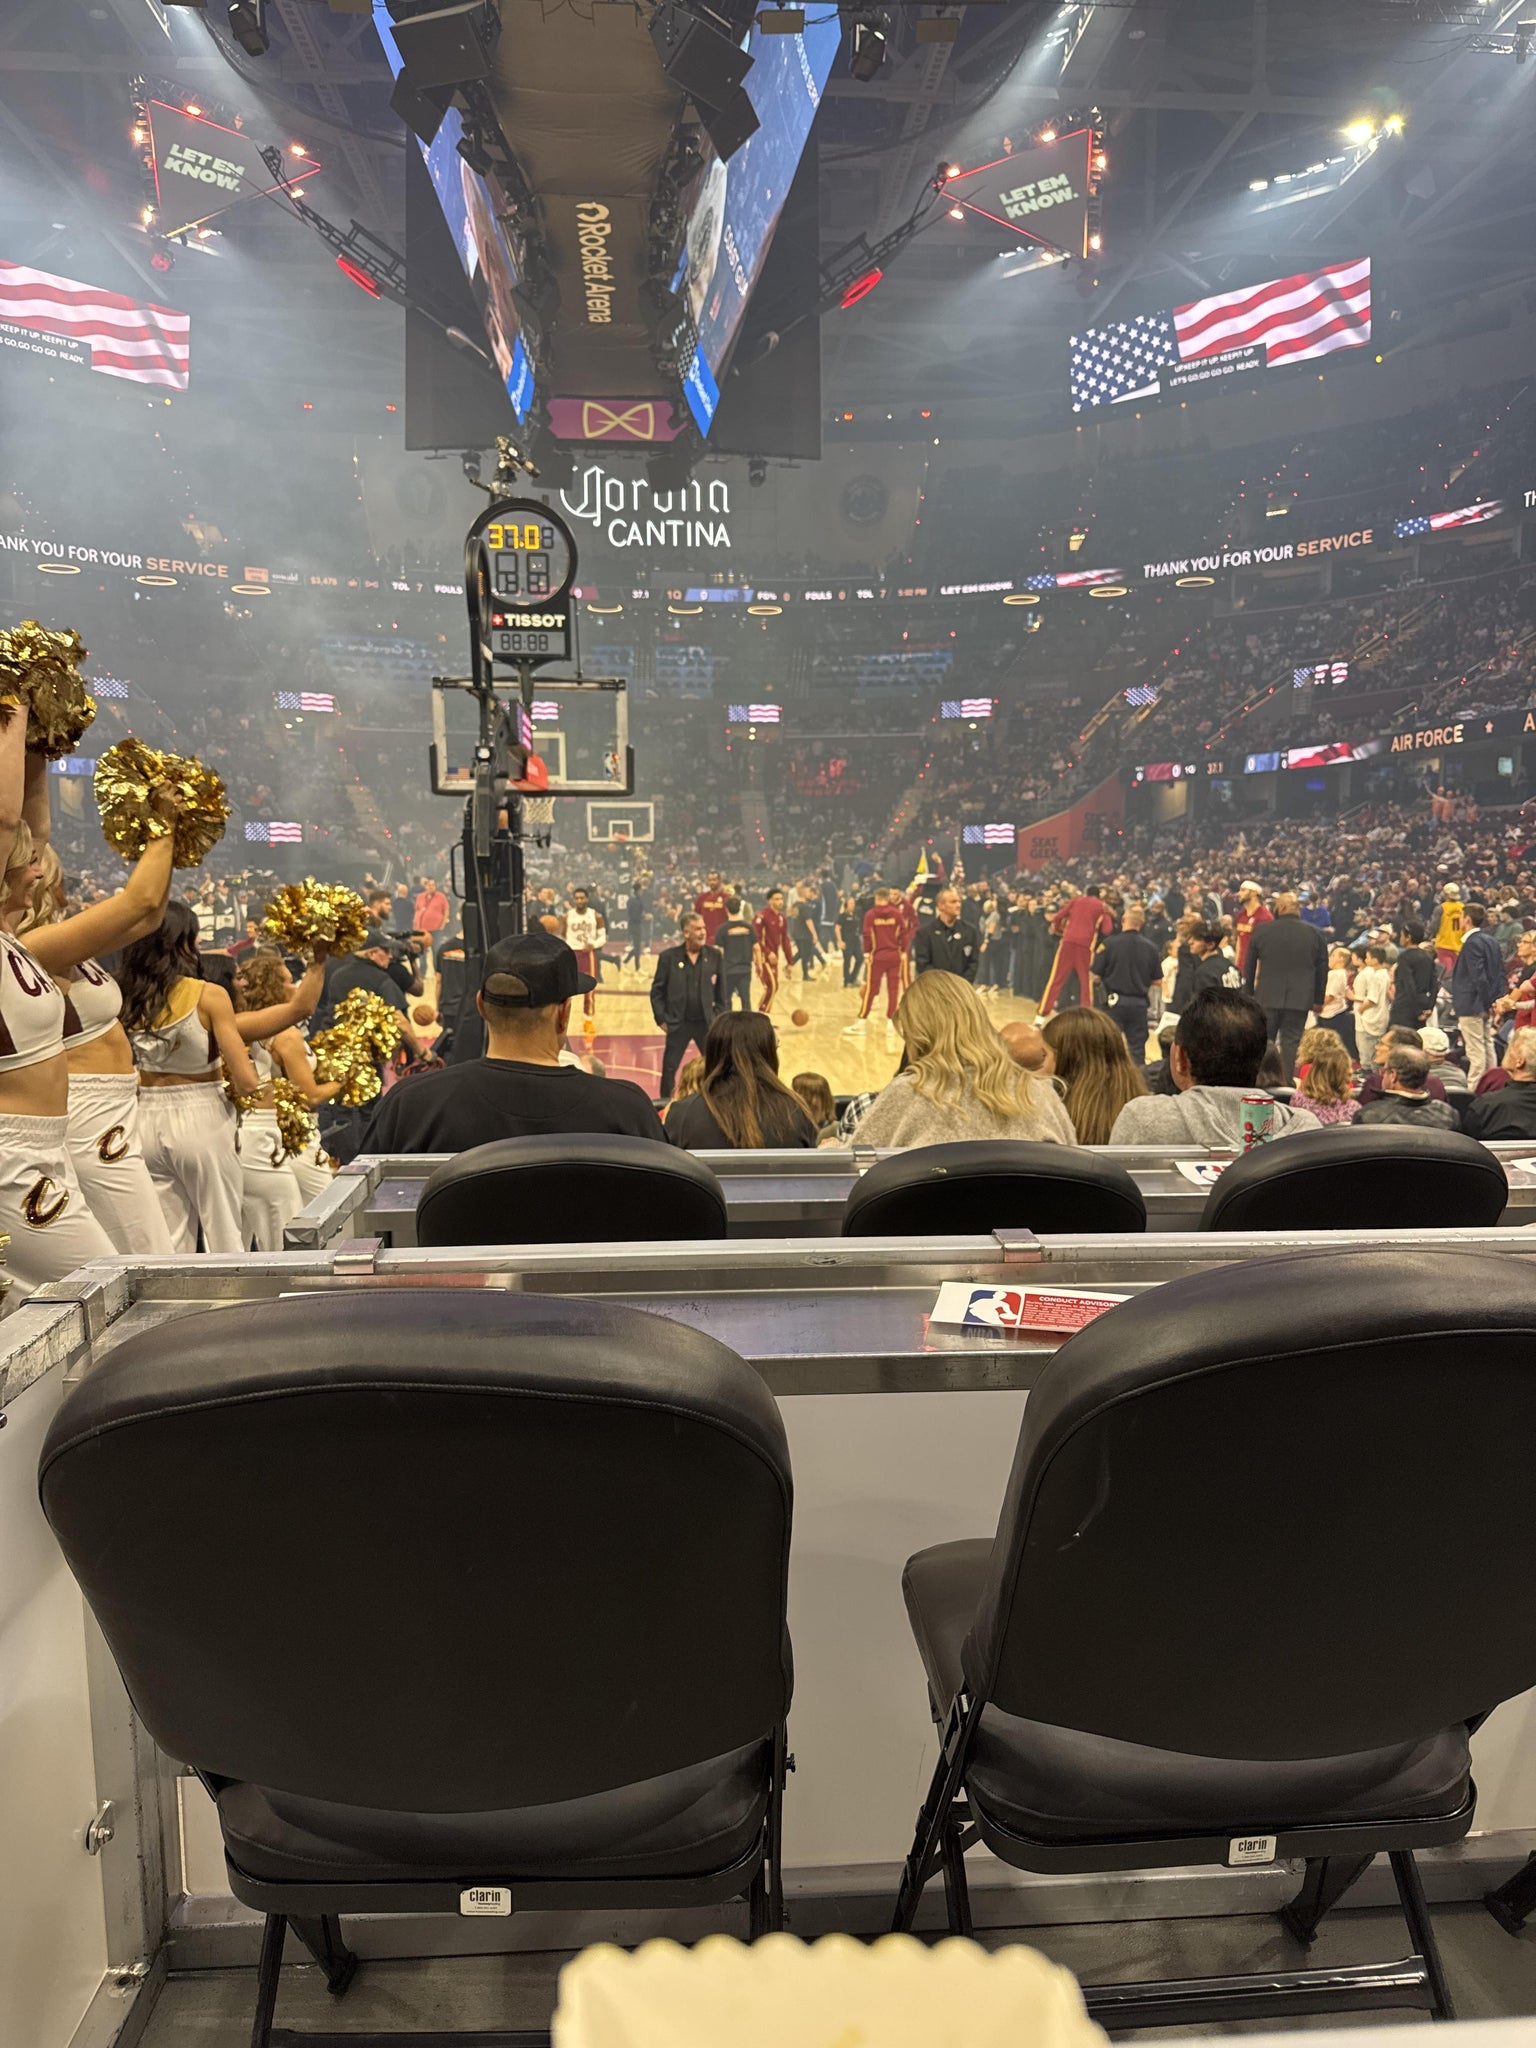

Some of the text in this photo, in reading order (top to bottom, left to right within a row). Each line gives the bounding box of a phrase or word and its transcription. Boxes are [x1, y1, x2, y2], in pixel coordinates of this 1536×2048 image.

[163, 156, 240, 192] KNOW.
[169, 143, 245, 177] LET EM
[999, 173, 1069, 206] LET EM
[1005, 186, 1079, 219] KNOW.
[577, 222, 616, 324] Rocket Arena
[488, 523, 541, 550] 37.0
[607, 518, 732, 548] CANTINA
[31, 539, 65, 558] YOU
[68, 545, 99, 563] FOR
[100, 550, 142, 569] YOUR
[146, 556, 229, 578] SERVICE
[1143, 528, 1374, 579] THANK YOU FOR YOUR SERVICE
[504, 612, 566, 628] TISSOT
[1390, 724, 1464, 753] AIR FORCE
[1038, 1296, 1120, 1308] CONDUCT ADVISORY
[1238, 1839, 1267, 1852] clarin
[469, 1889, 501, 1902] clarin
